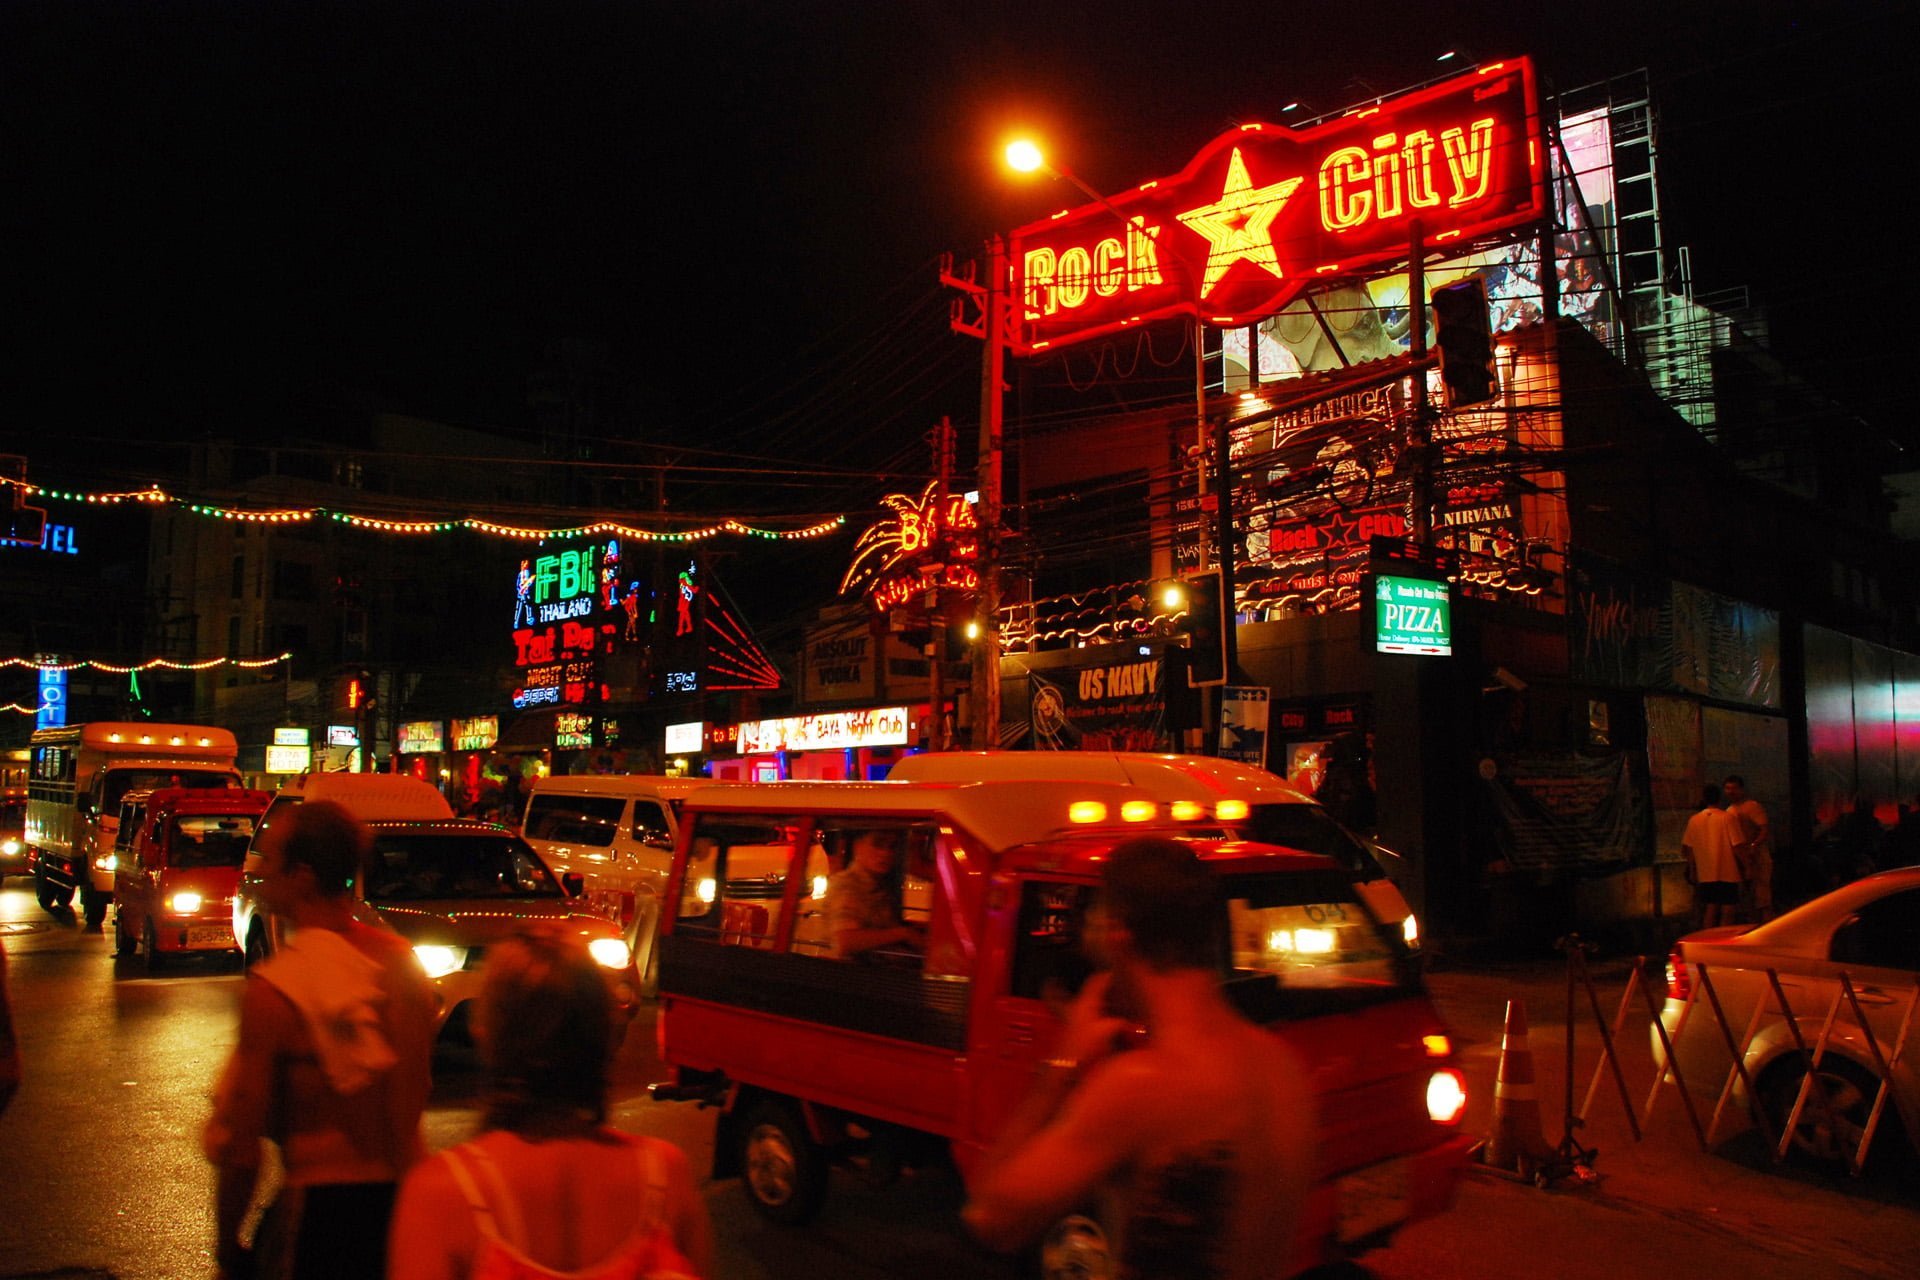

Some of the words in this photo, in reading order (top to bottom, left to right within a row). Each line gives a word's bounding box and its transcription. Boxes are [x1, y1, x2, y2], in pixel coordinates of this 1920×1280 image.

[1024, 215, 1163, 320] Rock
[1318, 118, 1495, 233] City
[1273, 382, 1395, 450] METALLICA
[1444, 504, 1513, 527] NIRVANA
[1271, 524, 1318, 552] Rock
[540, 597, 592, 623] THAILAND
[1384, 603, 1443, 632] PIZZA
[1079, 668, 1105, 701] US
[1107, 660, 1159, 698] NAVY
[817, 718, 841, 739] BAYA
[846, 716, 874, 743] Night
[879, 713, 903, 735] Club
[268, 750, 307, 759] EXPAT
